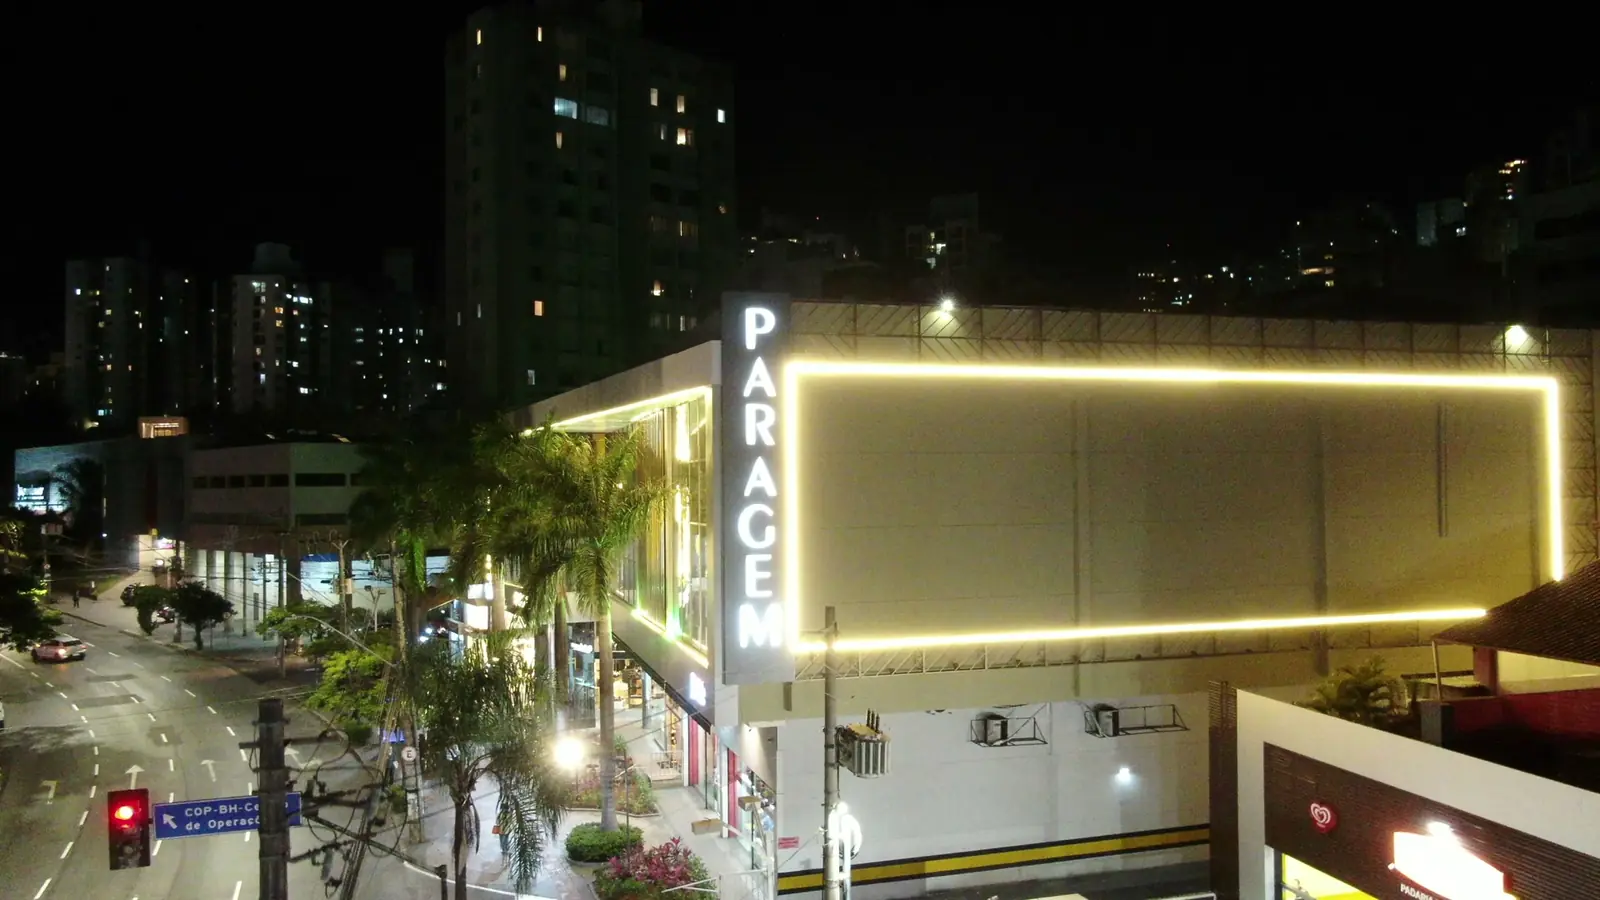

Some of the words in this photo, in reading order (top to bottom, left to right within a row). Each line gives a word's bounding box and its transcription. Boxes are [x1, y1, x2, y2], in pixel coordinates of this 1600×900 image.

[738, 306, 785, 649] PARAGEM
[184, 802, 288, 817] COP-BH-Ce
[185, 821, 201, 831] de
